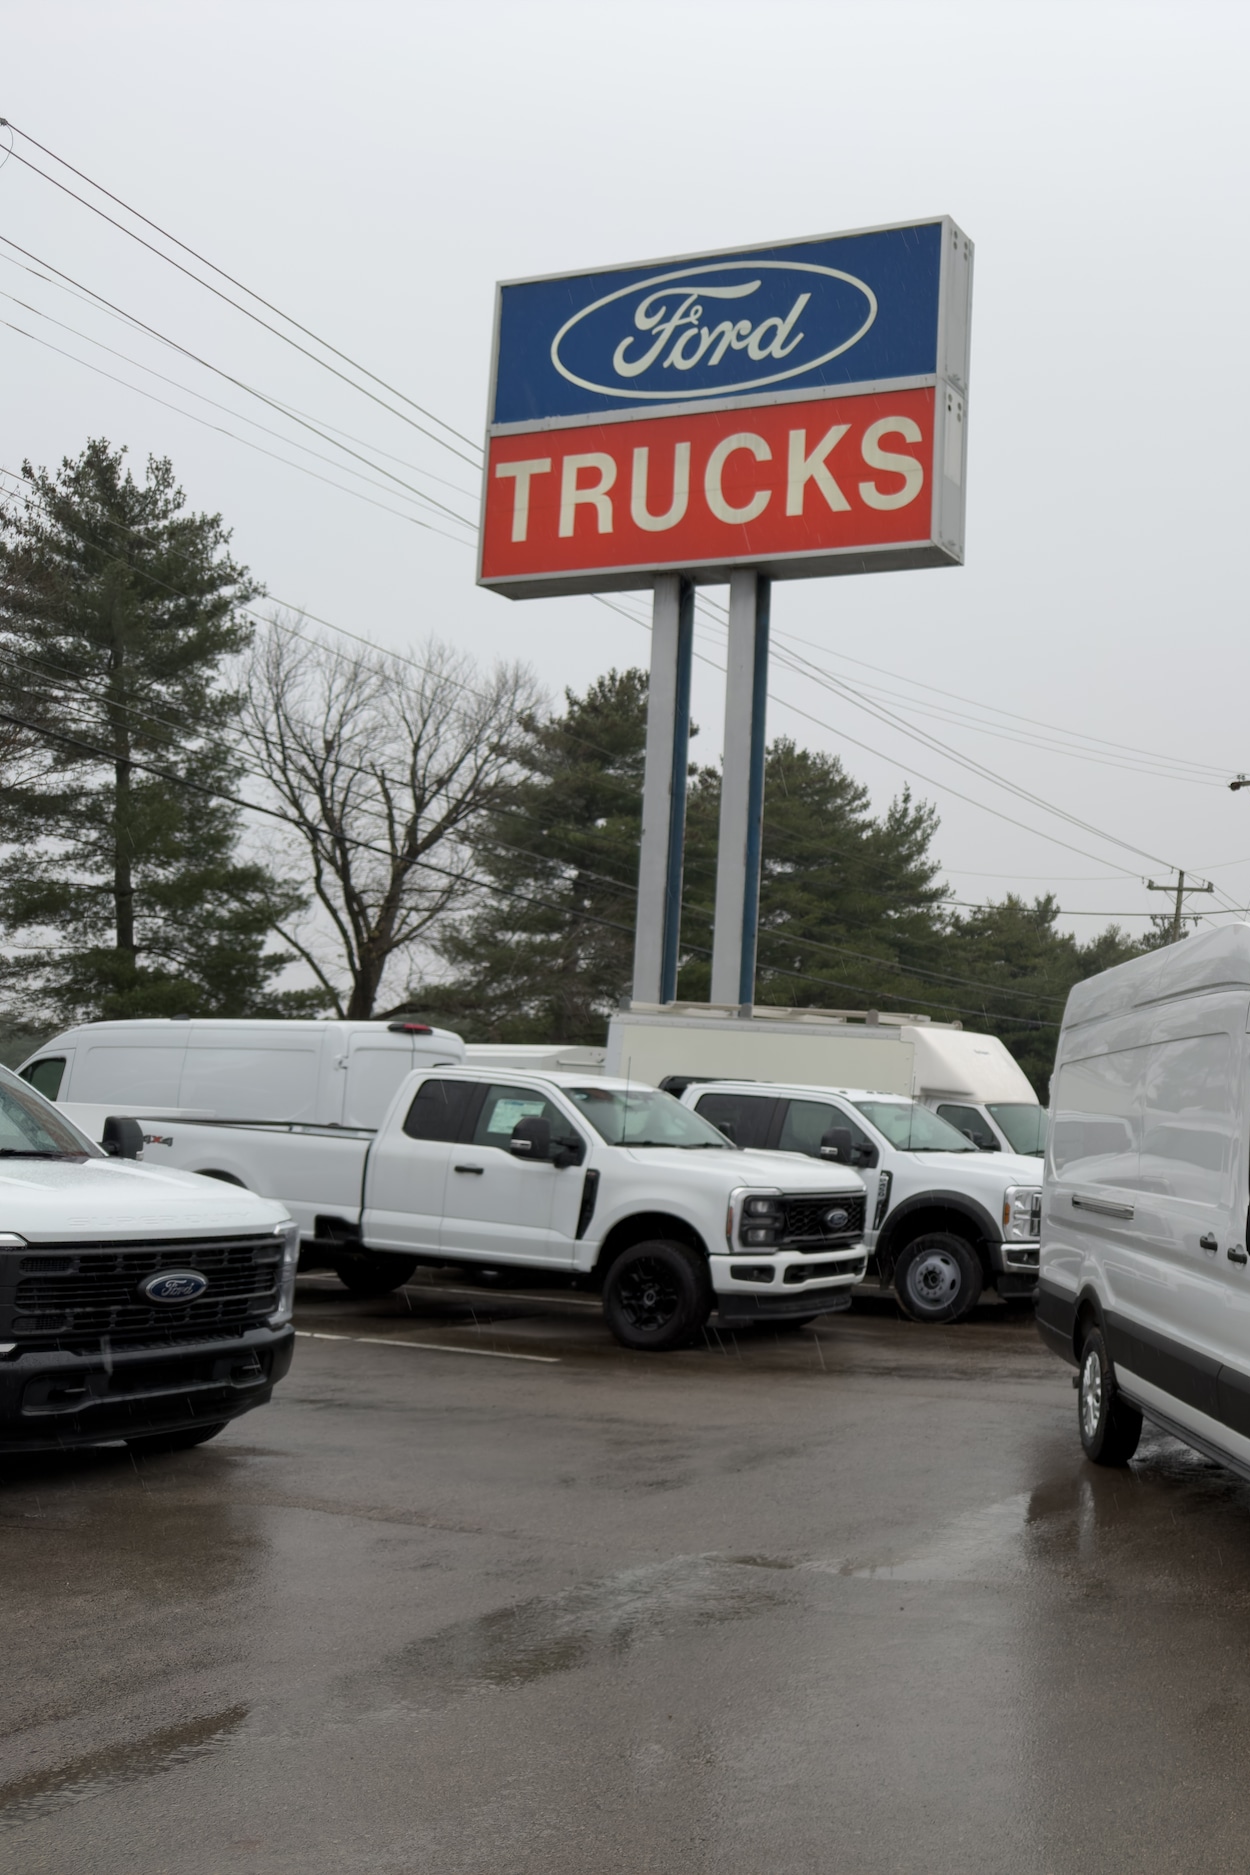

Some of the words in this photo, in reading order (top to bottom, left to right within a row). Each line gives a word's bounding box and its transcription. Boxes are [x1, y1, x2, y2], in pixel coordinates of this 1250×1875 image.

[612, 279, 811, 378] Ford
[496, 415, 924, 543] TRUCKS
[161, 1279, 195, 1297] Ford
